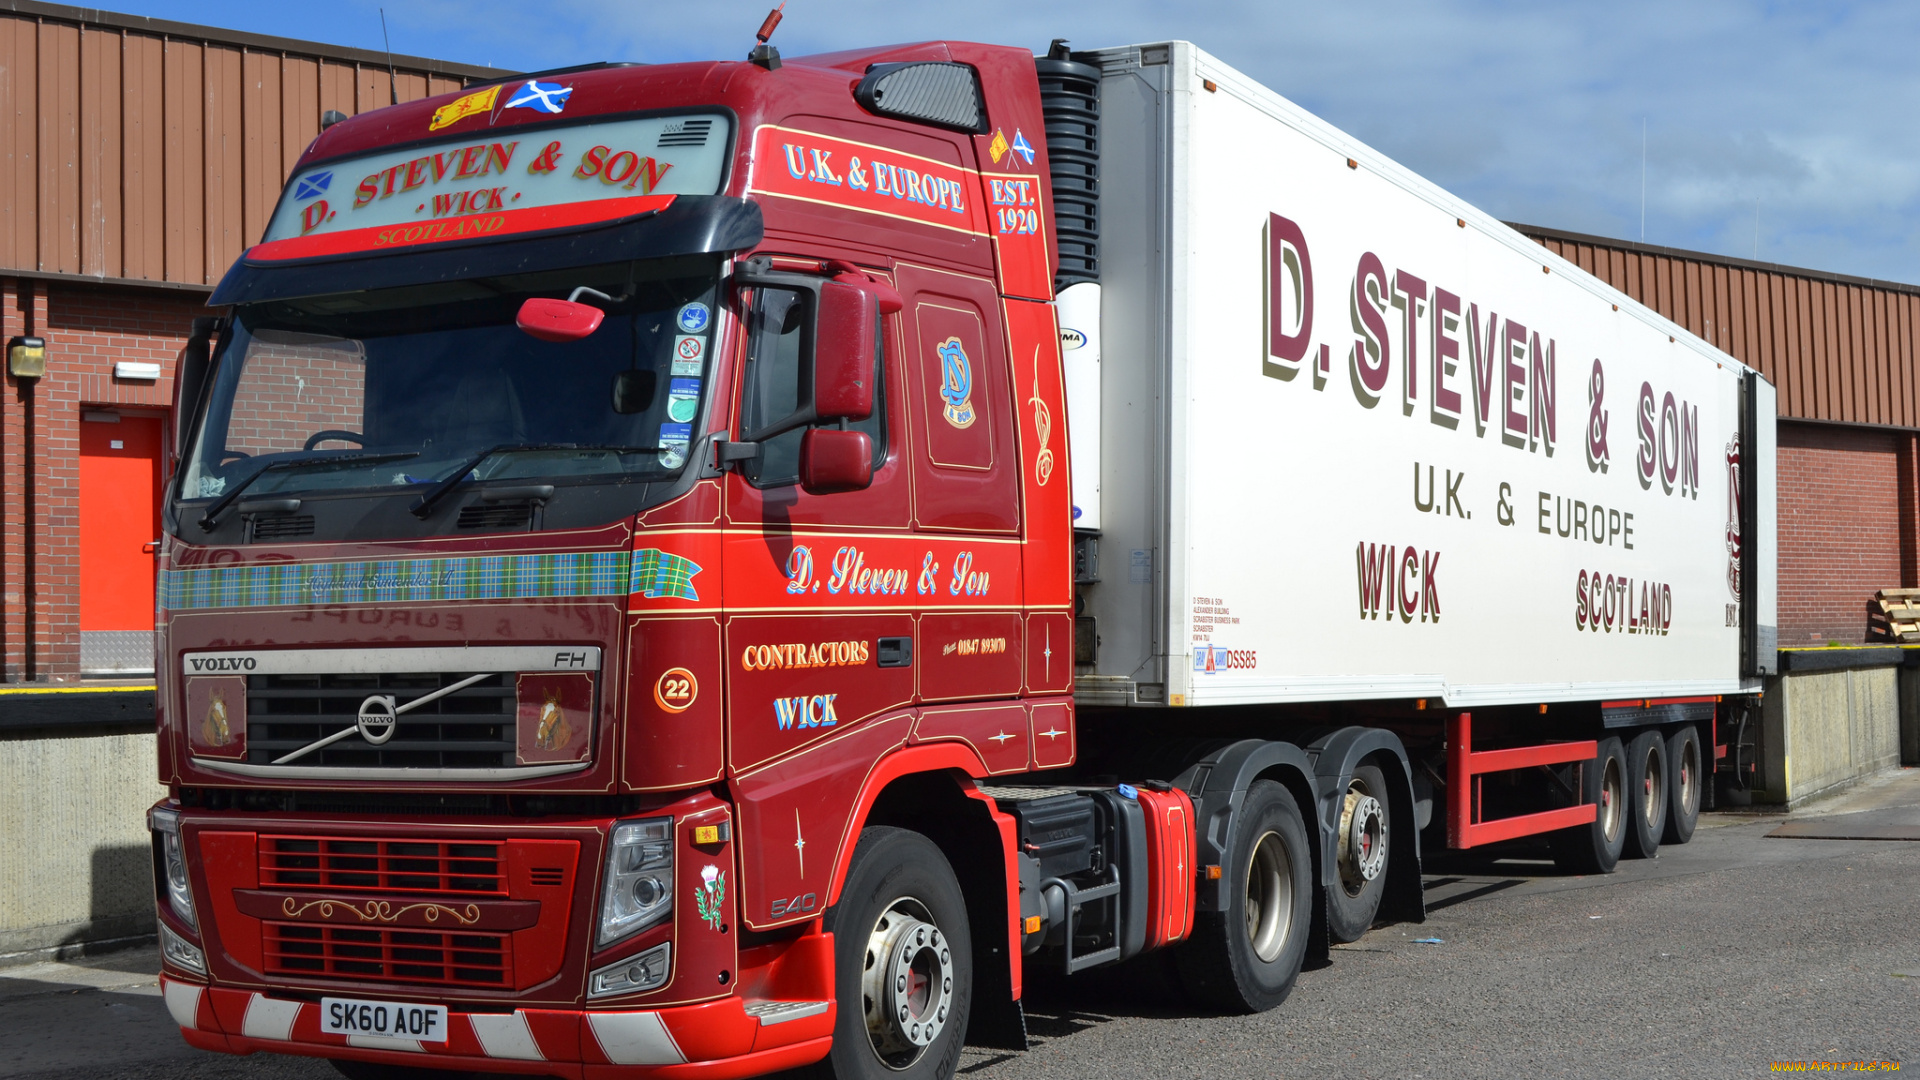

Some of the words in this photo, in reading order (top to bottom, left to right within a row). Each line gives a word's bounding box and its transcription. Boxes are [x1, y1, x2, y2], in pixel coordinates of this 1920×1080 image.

[300, 200, 336, 236] D.
[354, 141, 519, 208] STEVEN
[527, 140, 563, 175] &
[573, 144, 675, 194] SON
[783, 144, 843, 187] U.K.
[848, 156, 869, 191] &
[870, 161, 965, 214] EUROPE
[989, 179, 1035, 206] EST.
[431, 186, 506, 218] WICK
[373, 216, 505, 246] SCOTLAND
[997, 208, 1038, 235] 1920
[1262, 211, 1330, 391] D.
[1348, 251, 1556, 458] STEVEN
[1586, 358, 1610, 474] &
[1637, 380, 1700, 500] SON
[957, 409, 971, 422] SON
[1414, 461, 1472, 520] U.K.
[1497, 481, 1515, 527] &
[1538, 491, 1635, 551] EUROPE
[303, 573, 364, 596] Highland
[786, 544, 820, 594] D.
[827, 546, 909, 594] Steven
[917, 550, 939, 594] &
[950, 551, 990, 596] Son
[1356, 541, 1441, 624] WICK
[1576, 568, 1672, 637] SCOTLAND
[554, 652, 586, 667] FH
[742, 640, 869, 671] CONTRACTORS
[958, 639, 979, 655] 01847
[981, 637, 1006, 654] 893070
[1226, 650, 1256, 669] DSS85
[190, 657, 256, 671] VOLVO
[664, 680, 689, 699] 22
[773, 694, 838, 730] WICK
[770, 893, 816, 919] 540
[330, 1003, 387, 1032] SK60
[394, 1007, 438, 1035] AOF
